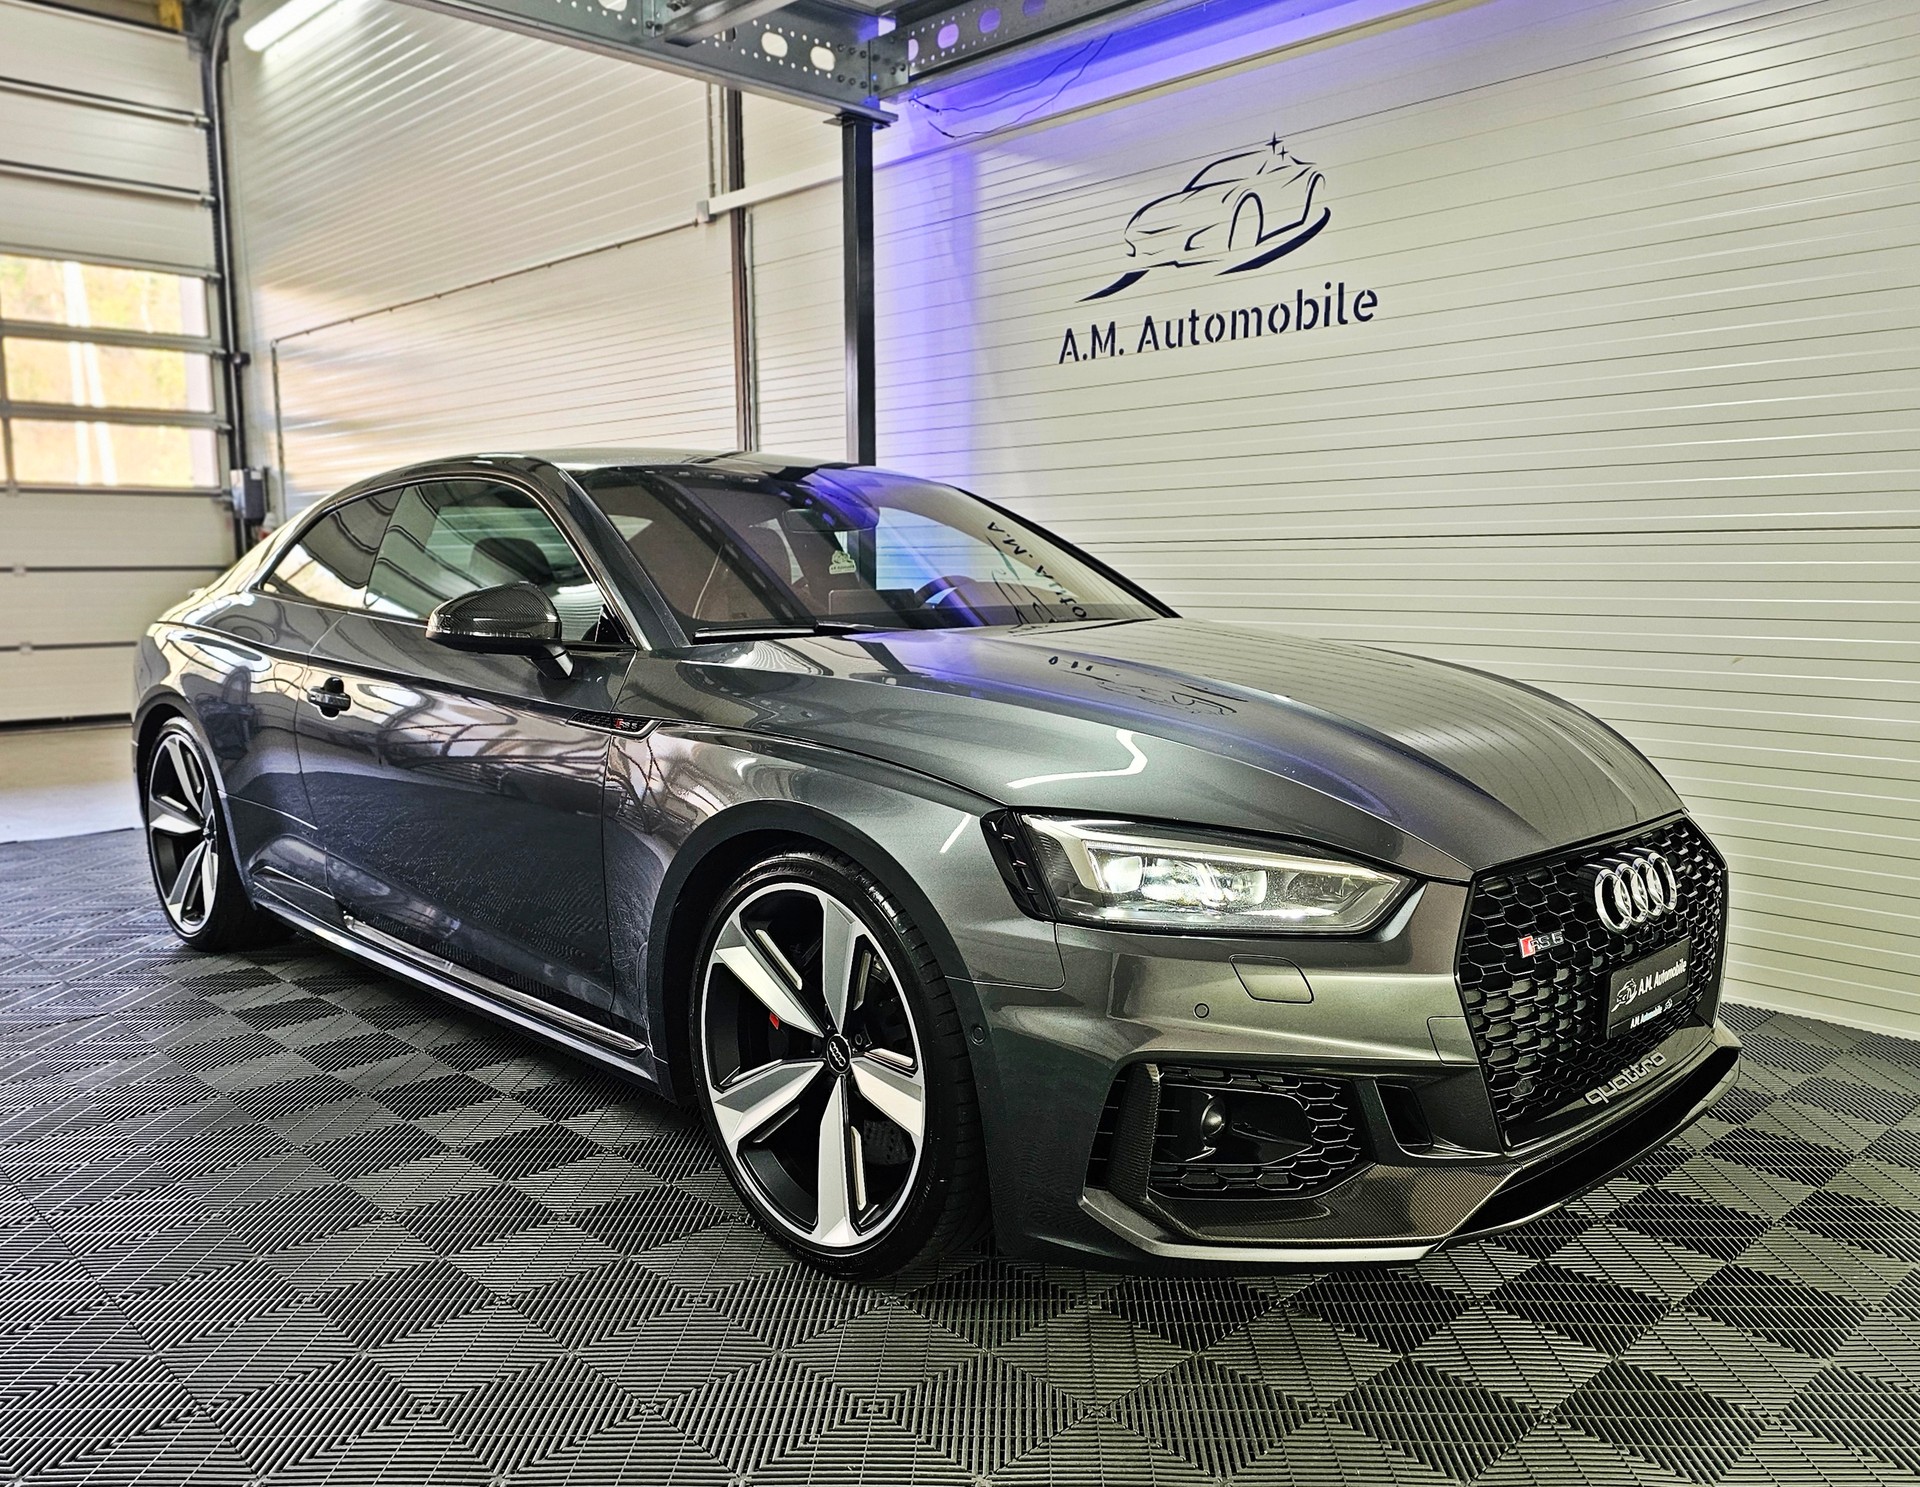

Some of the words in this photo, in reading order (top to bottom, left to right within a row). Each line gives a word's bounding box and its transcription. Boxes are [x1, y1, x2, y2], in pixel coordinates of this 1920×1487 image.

[1059, 321, 1125, 364] A.M.
[1137, 281, 1378, 354] Automobile
[1653, 958, 1687, 989] Automobile
[1584, 1051, 1667, 1104] quattro
